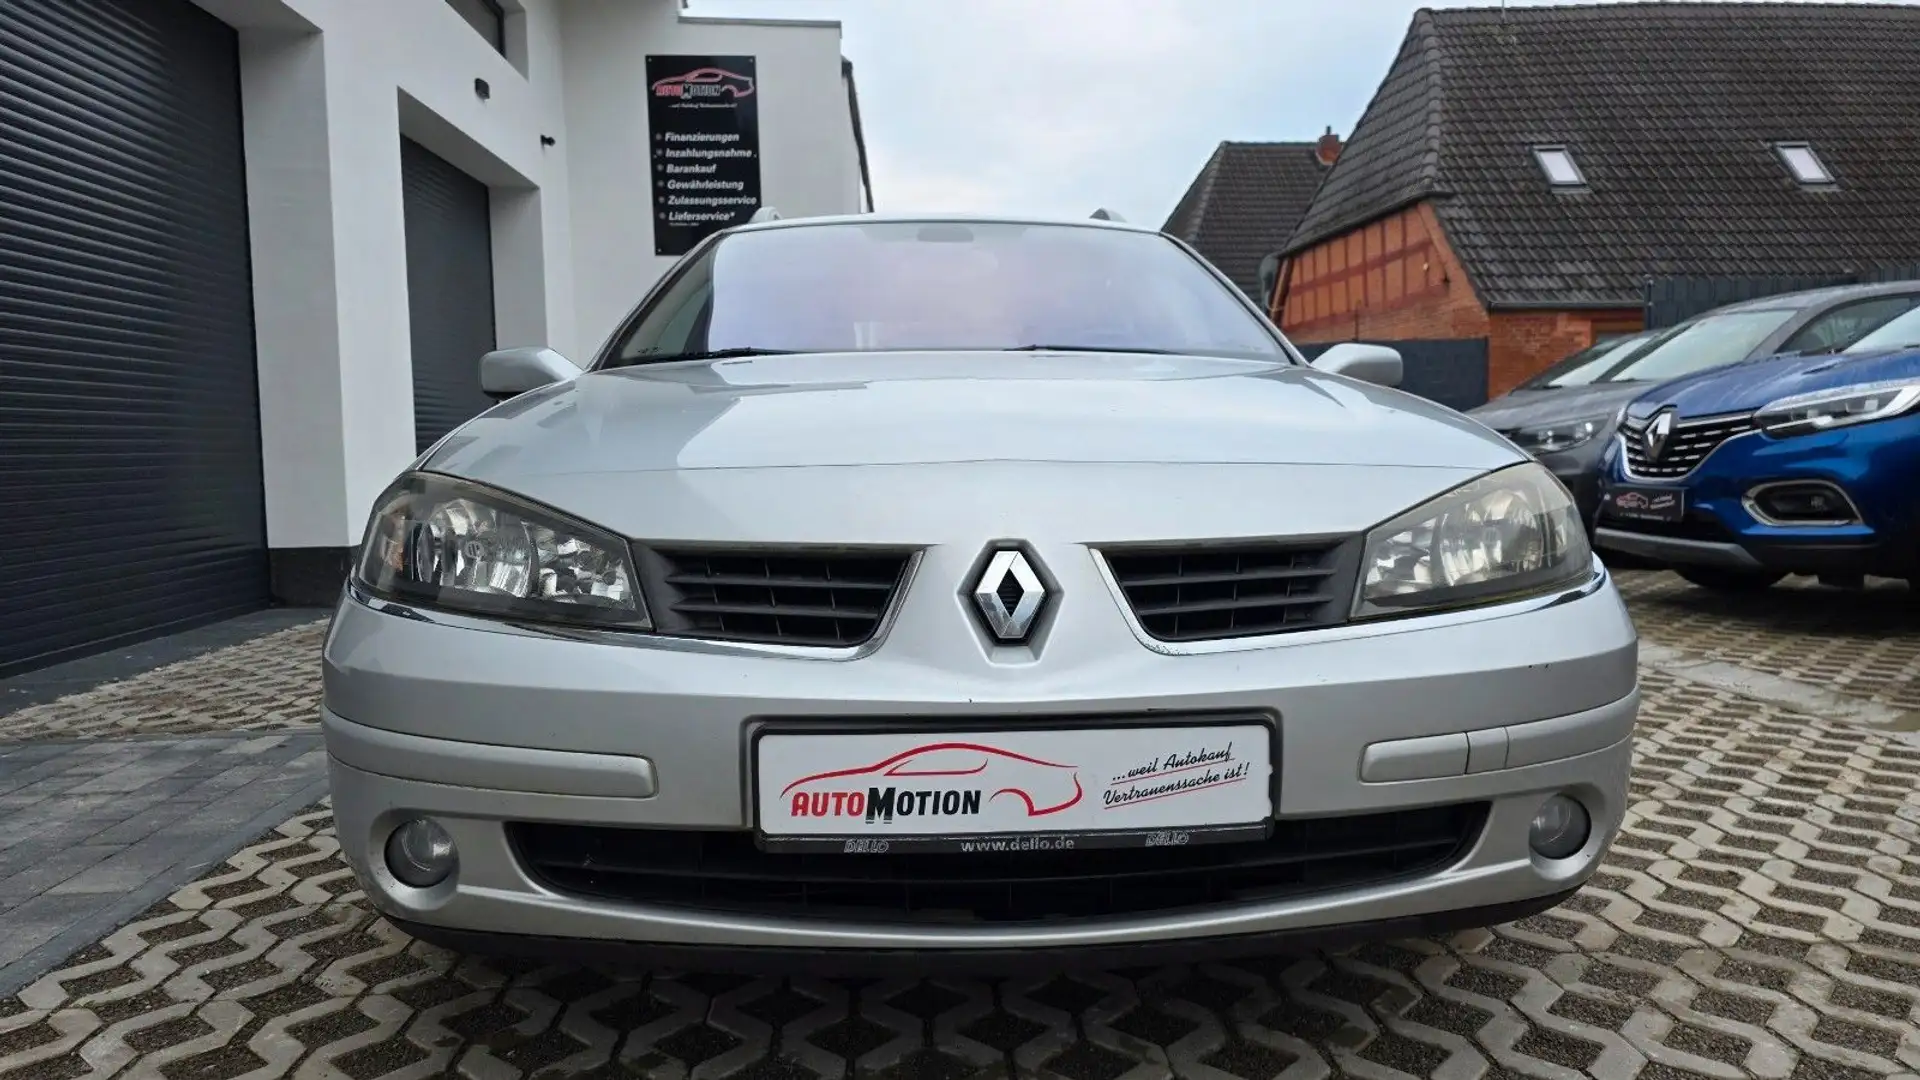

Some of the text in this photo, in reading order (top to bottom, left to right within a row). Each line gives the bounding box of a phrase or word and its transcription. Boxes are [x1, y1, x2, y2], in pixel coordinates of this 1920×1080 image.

[664, 131, 740, 143] Finanzierungen
[665, 148, 752, 159] Inzahlungsnahme
[666, 163, 717, 174] Barankauf
[667, 179, 744, 190] Gewährleistung
[667, 195, 757, 207] Zulassungsservice
[1163, 741, 1232, 771] Autokauf
[1102, 761, 1251, 805] Vertrauenssache ist!
[960, 835, 1075, 852] www.dello.de
